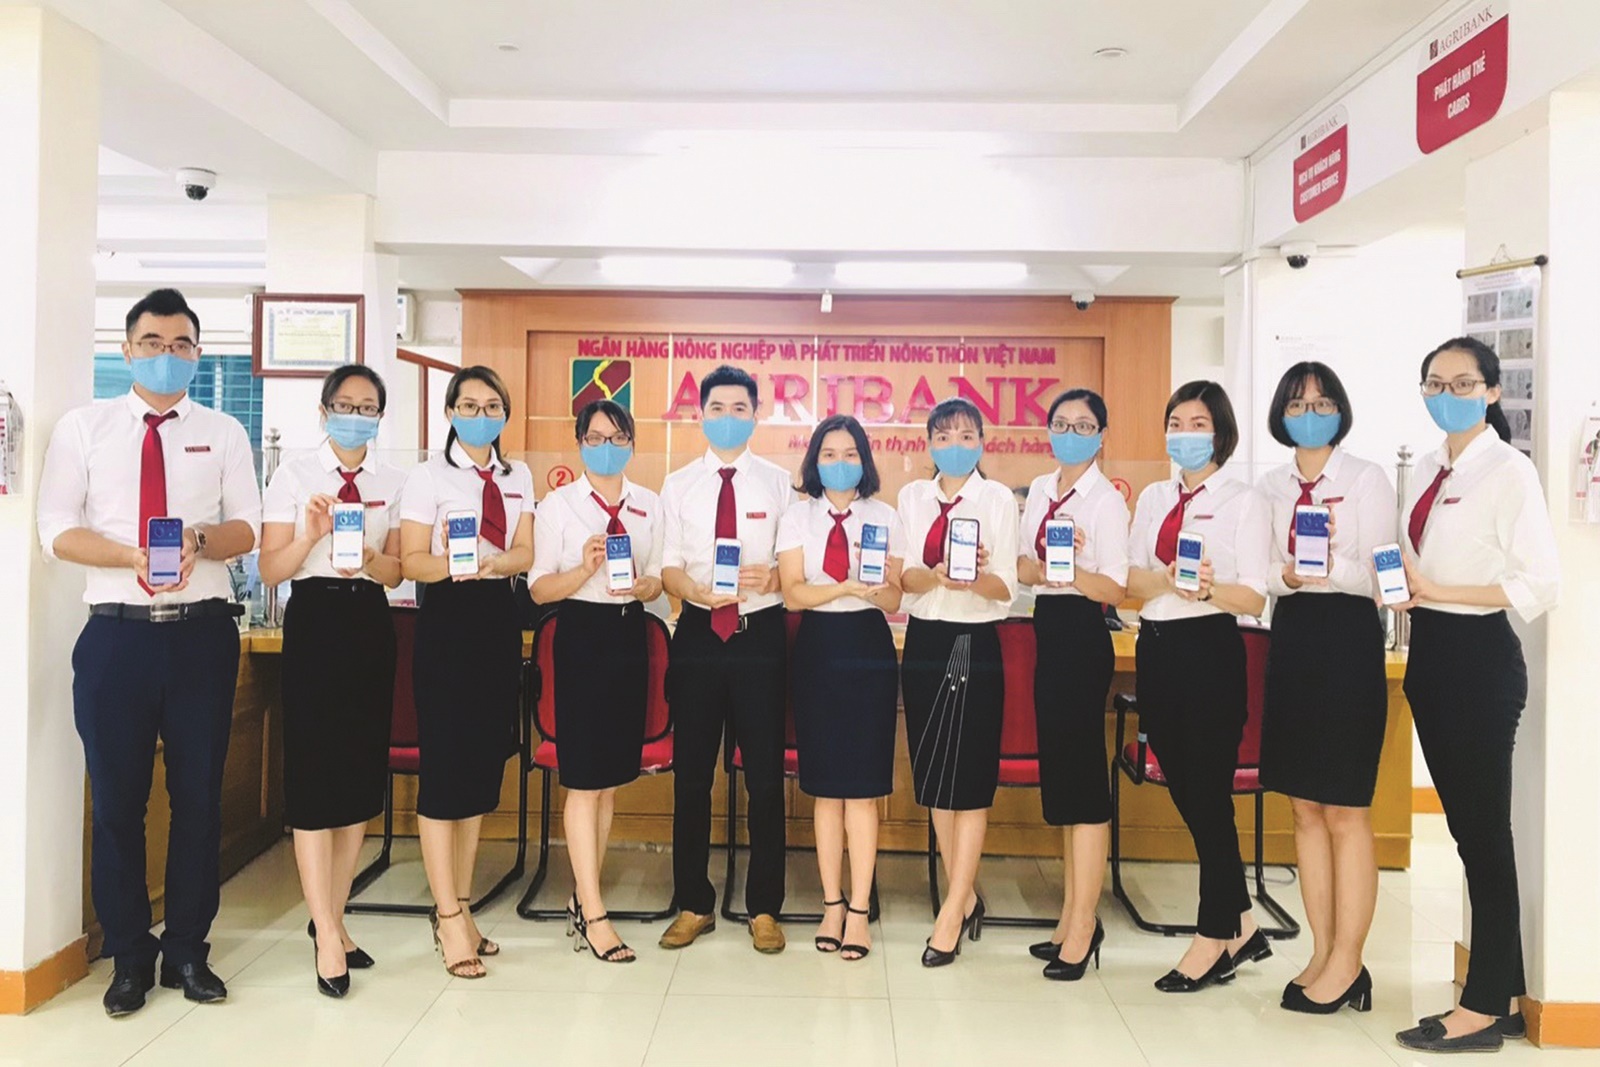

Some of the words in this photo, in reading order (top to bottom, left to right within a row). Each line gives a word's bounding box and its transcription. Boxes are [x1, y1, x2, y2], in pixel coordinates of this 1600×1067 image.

[1440, 5, 1492, 53] AGRIBANK
[1448, 92, 1470, 118] CARDS
[578, 336, 622, 357] NGÂN
[626, 337, 669, 358] HÀNG
[673, 337, 717, 359] NÔNG
[721, 339, 776, 364] NGHIỆP
[779, 339, 797, 360] VÀ
[801, 339, 840, 361] PHÁT
[843, 338, 885, 362] TRIỂN
[889, 342, 933, 363] NÔNG
[937, 343, 978, 364] THÔN
[983, 343, 1016, 368] VIỆT
[1018, 347, 1056, 364] NAM
[661, 371, 1060, 427] ARIBANK
[556, 470, 567, 487] 2
